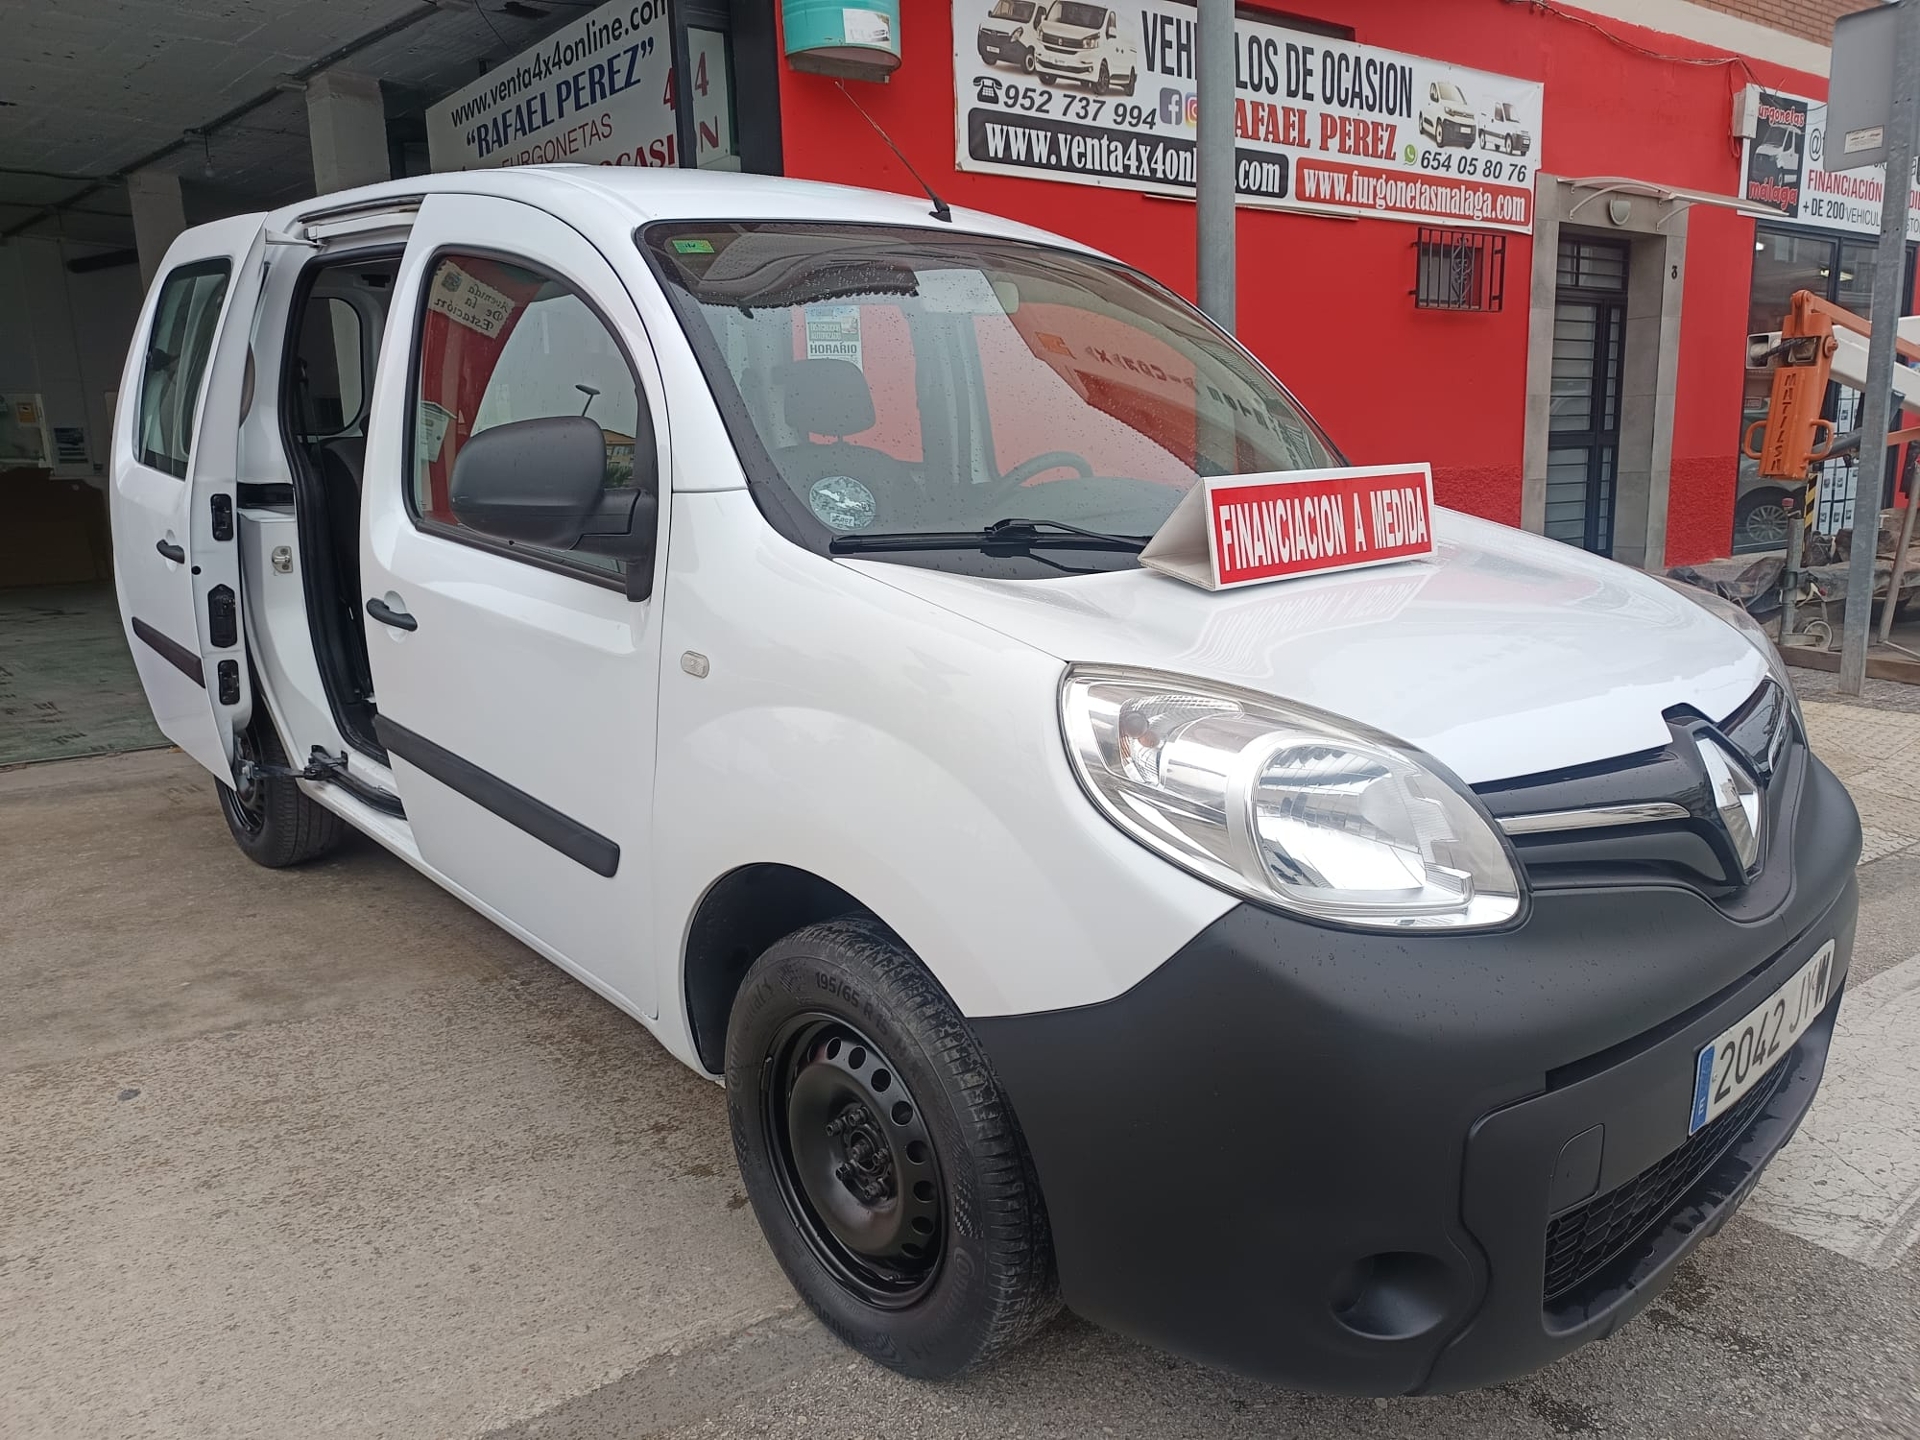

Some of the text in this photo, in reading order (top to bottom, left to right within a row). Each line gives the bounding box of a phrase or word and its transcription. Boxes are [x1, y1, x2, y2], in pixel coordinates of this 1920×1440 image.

[1286, 42, 1314, 102] DE
[1321, 50, 1413, 118] OCASION
[1003, 84, 1157, 130] 952 737 994
[1235, 97, 1397, 161] AFAEL PEREZ
[1759, 105, 1805, 127] urgonetas
[1421, 149, 1528, 183] 654 05 80 76
[1303, 168, 1525, 223] www.furgonetasmalaga.com
[1811, 199, 1824, 217] DE
[1827, 201, 1845, 220] 200
[1846, 206, 1881, 227] VEHICUL
[810, 343, 858, 355] HORARIO
[1219, 487, 1428, 572] FINANCIACION A MEDIDA
[815, 971, 860, 1008] 195/65
[1714, 999, 1785, 1105] 2042
